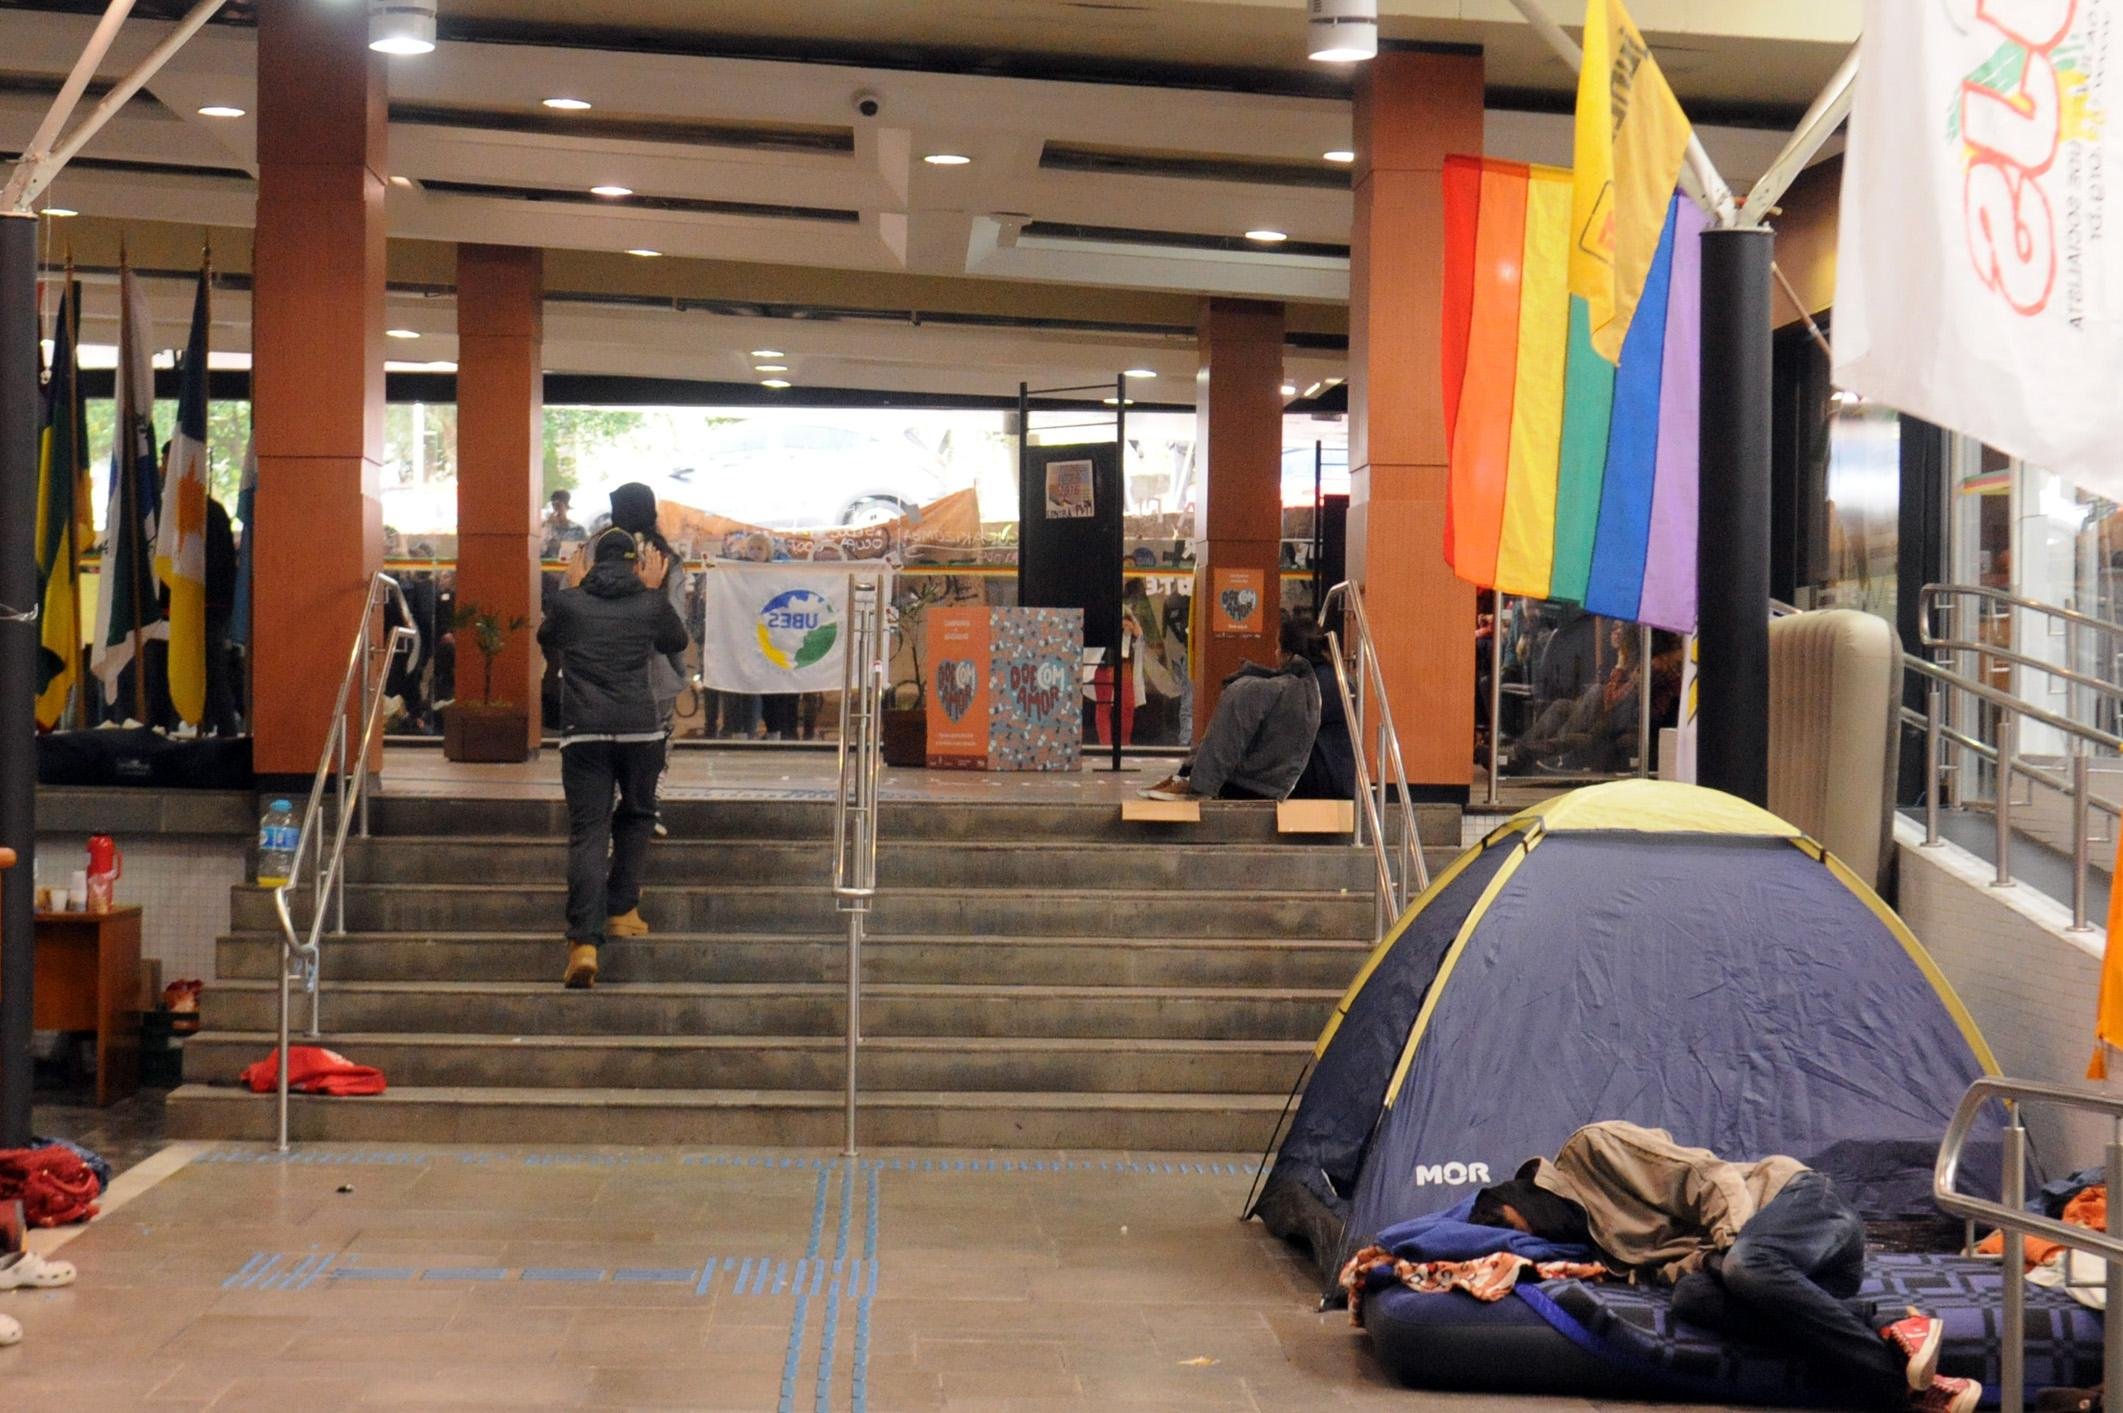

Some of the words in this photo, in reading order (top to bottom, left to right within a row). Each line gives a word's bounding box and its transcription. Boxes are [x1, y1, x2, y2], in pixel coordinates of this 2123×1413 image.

[955, 661, 977, 696] COM
[1009, 663, 1038, 692] DOE
[1036, 662, 1064, 696] COM
[1016, 686, 1060, 722] AMOR
[1415, 1161, 1491, 1186] MOR
